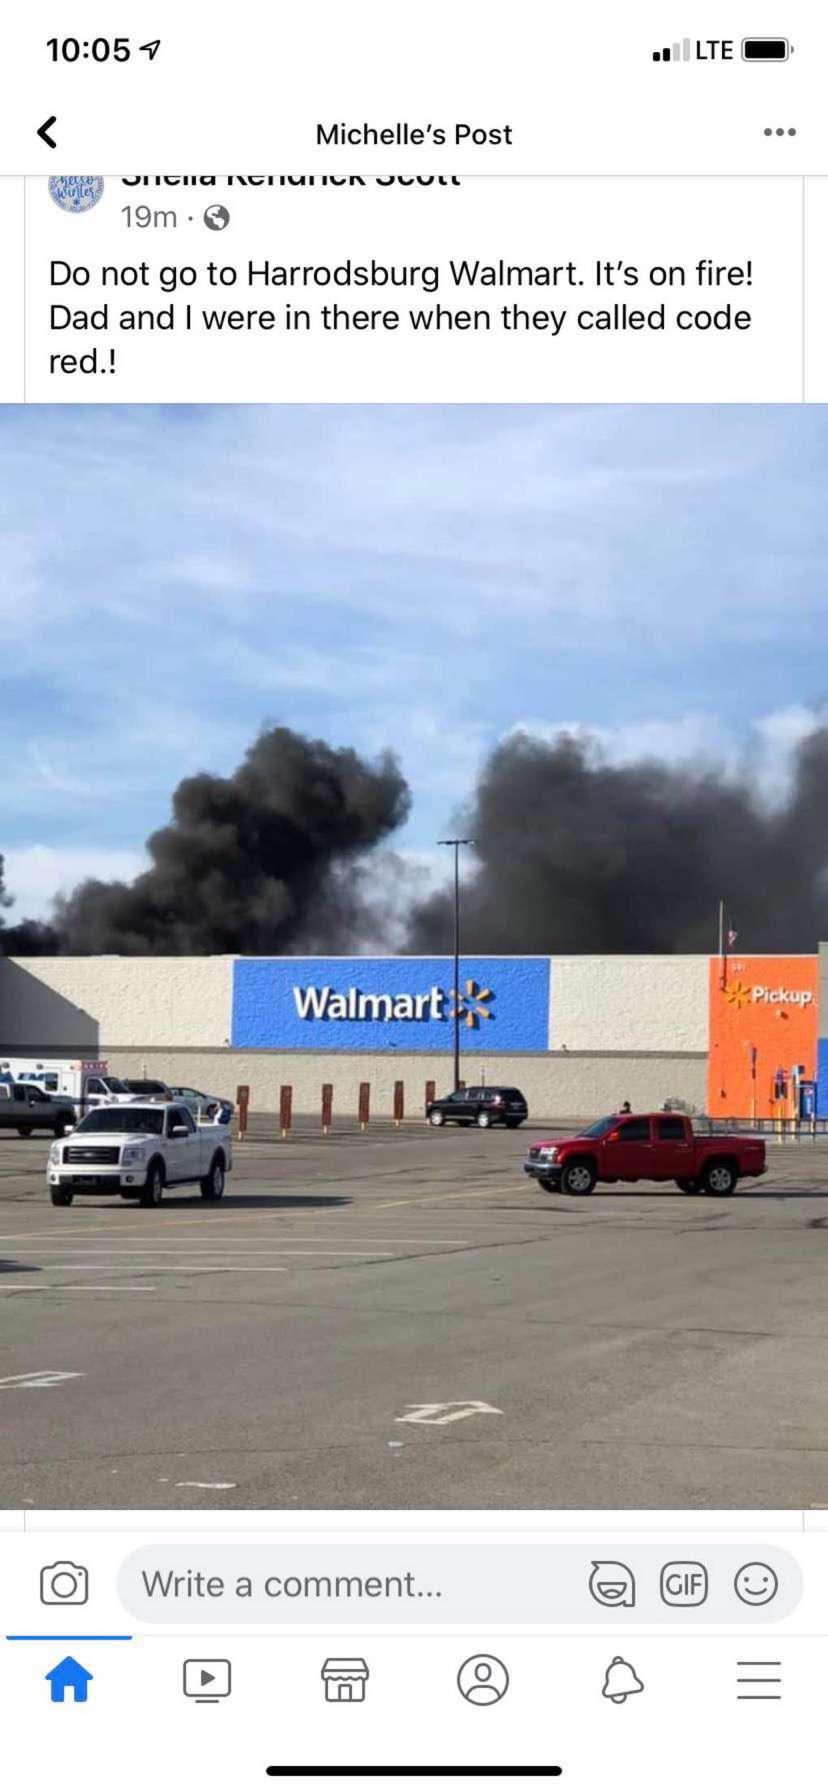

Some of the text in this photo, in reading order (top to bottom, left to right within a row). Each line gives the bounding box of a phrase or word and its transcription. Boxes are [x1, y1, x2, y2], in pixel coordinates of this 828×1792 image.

[46, 37, 131, 63] 10:05
[696, 40, 734, 60] LTE
[316, 122, 513, 145] Michelle’s Post
[121, 205, 177, 228] 19m
[50, 259, 753, 294] Do not go to Harrodsburg Walmart. It’s on fire!
[50, 303, 752, 338] Dad and I were in there when they called code
[50, 347, 116, 374] red.!
[293, 985, 444, 1020] Walmart
[752, 985, 813, 1007] Pickup
[141, 1569, 443, 1598] Write a comment...
[665, 1573, 702, 1595] GIF
